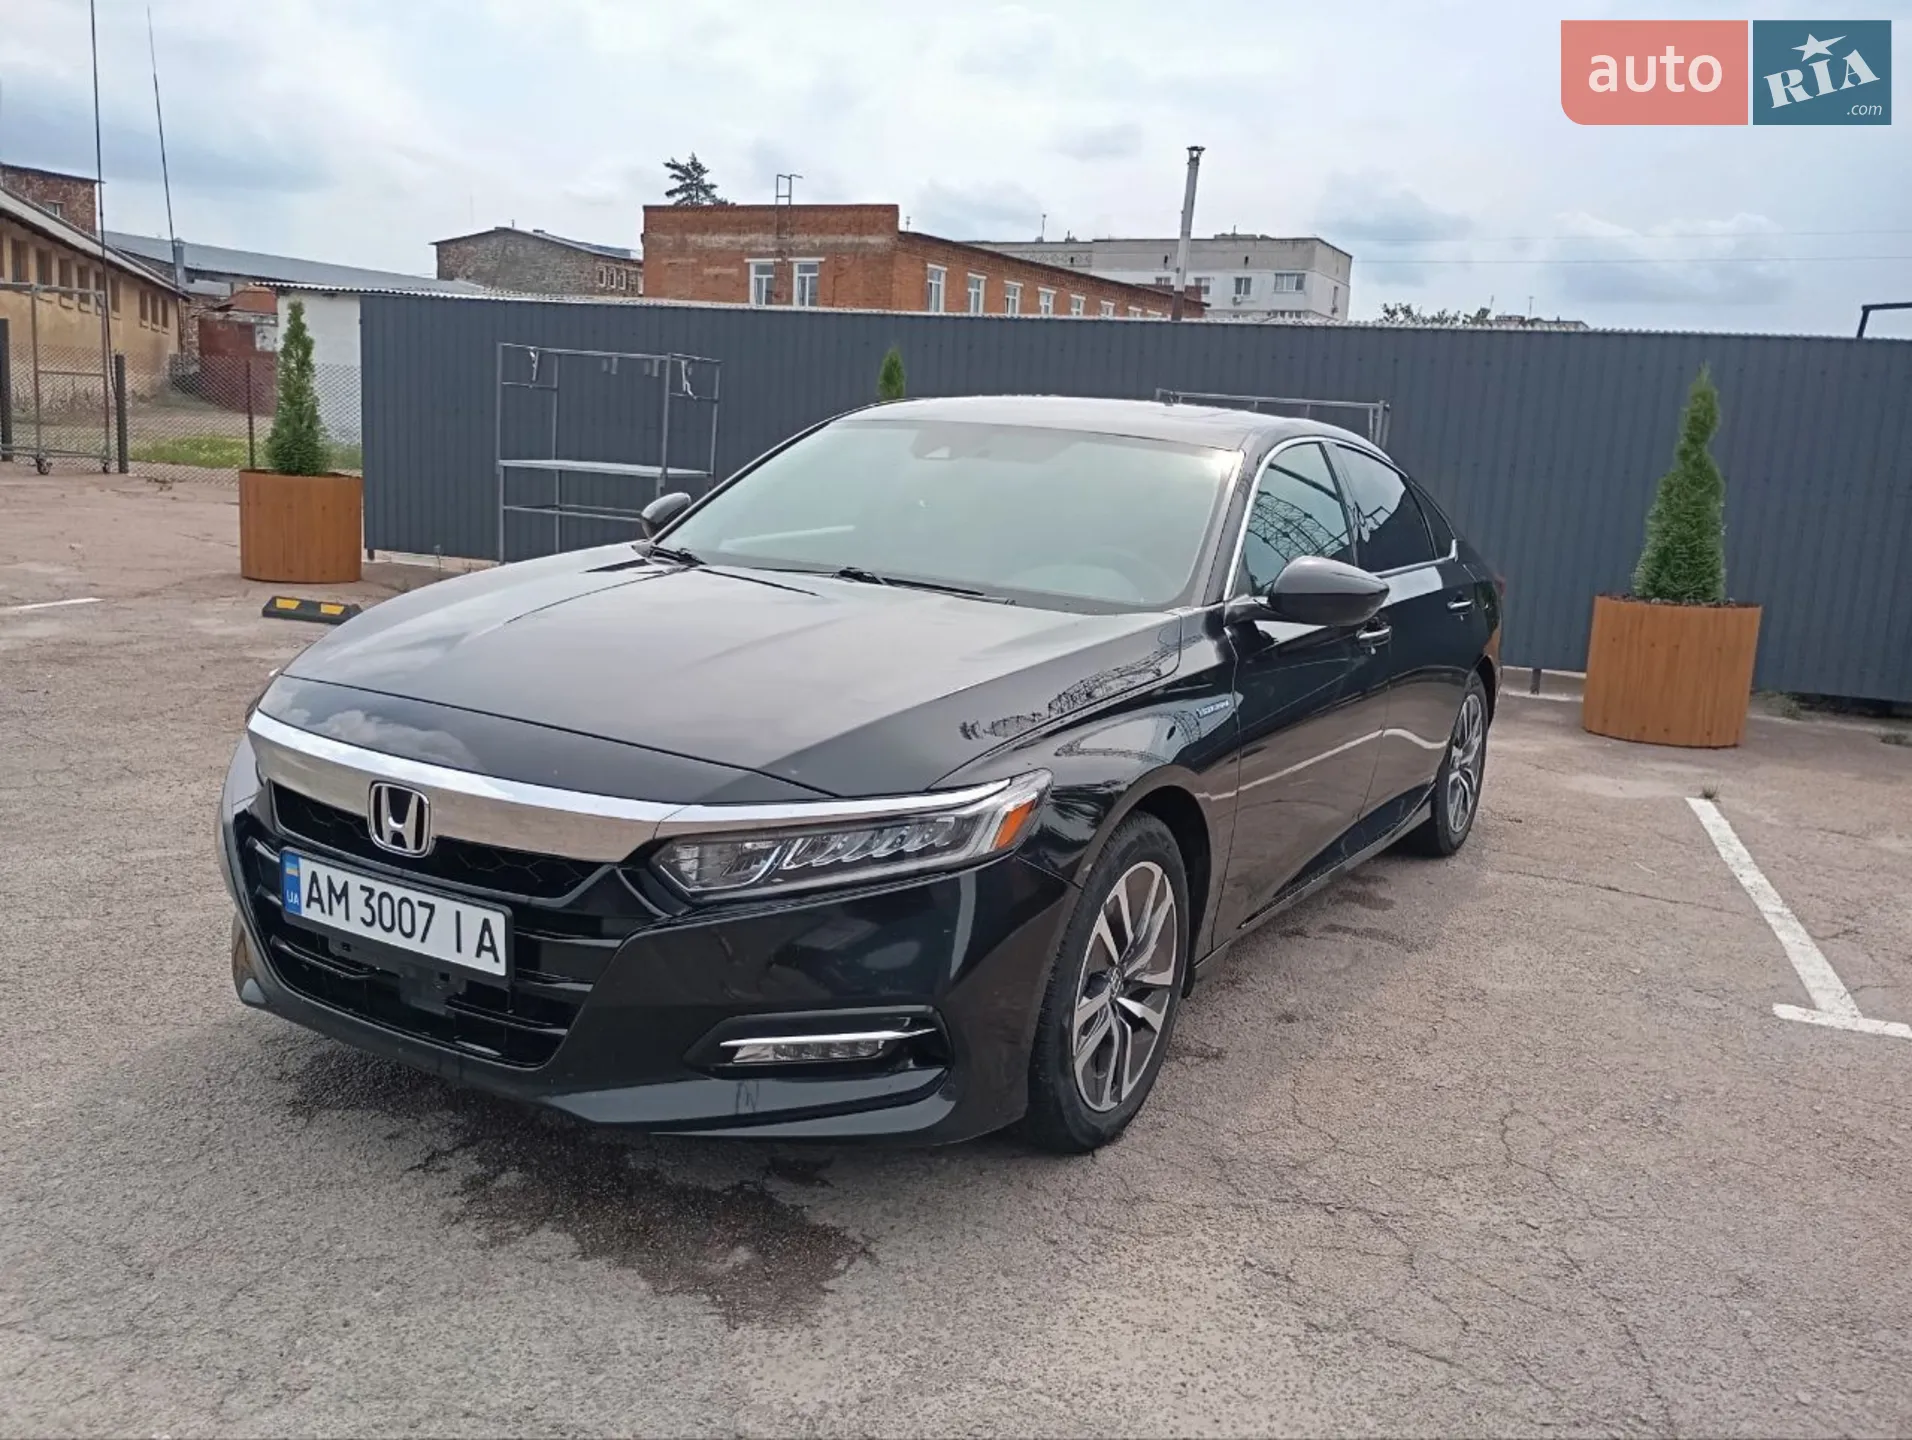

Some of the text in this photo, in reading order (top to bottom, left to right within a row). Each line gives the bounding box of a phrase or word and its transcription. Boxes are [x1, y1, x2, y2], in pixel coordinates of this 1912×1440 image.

[286, 890, 300, 906] UA
[305, 870, 350, 921] AM
[359, 884, 436, 943] 3007
